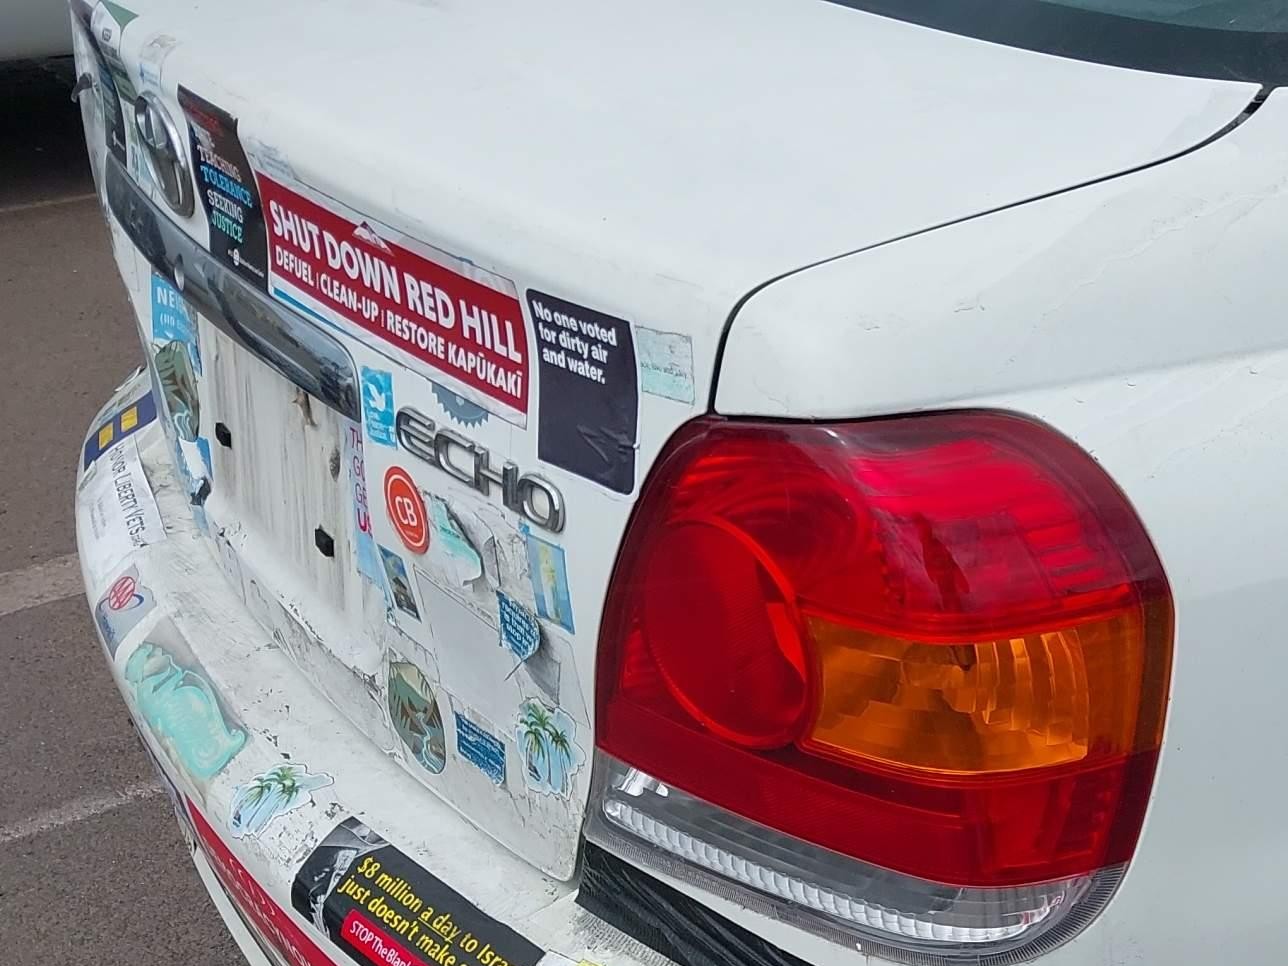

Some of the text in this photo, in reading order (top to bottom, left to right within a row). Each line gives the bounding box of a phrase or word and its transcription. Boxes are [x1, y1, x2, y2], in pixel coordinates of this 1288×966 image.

[200, 165, 252, 208] TOLERANCE
[207, 189, 243, 223] SEEKING
[212, 210, 242, 243] JUSTICE
[269, 199, 321, 259] SHUT
[323, 230, 400, 304] DOWN
[403, 271, 455, 329] RED
[459, 299, 522, 364] HILL
[275, 245, 314, 286] DEFUEL
[320, 274, 379, 322] CLEAN-UP
[386, 309, 445, 360] RESTORE
[532, 300, 617, 346] No one voted
[538, 322, 608, 364] for dirty air
[542, 348, 606, 385] and water.
[396, 405, 566, 535] ECHO
[114, 472, 138, 511] LIBERTY
[395, 497, 418, 526] CB
[125, 508, 146, 537] VETS
[337, 875, 371, 905] just
[368, 899, 419, 941] doesn't
[357, 856, 381, 879] $8
[375, 872, 423, 913] million
[420, 906, 434, 922] a
[433, 914, 461, 944] day
[459, 932, 479, 953] to
